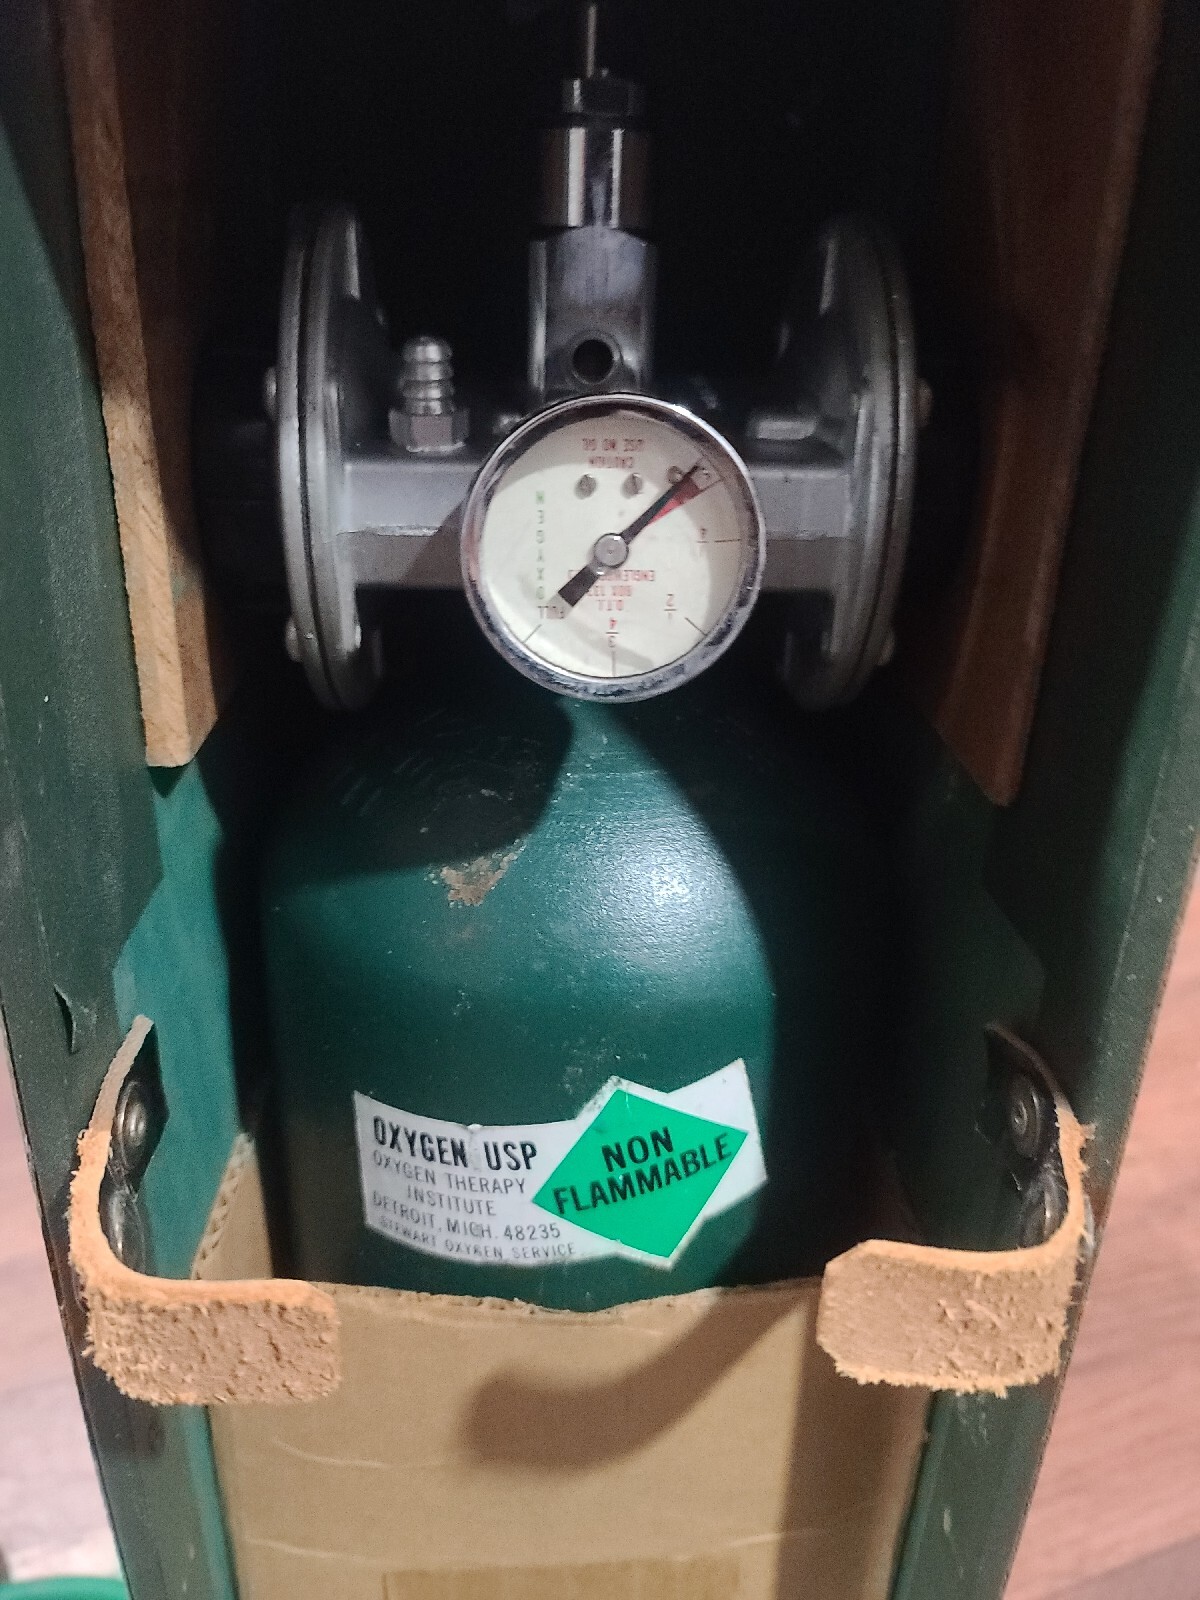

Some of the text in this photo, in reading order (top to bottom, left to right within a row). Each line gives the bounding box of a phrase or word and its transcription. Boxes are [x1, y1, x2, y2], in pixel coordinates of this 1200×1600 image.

[373, 1115, 537, 1171] OXYGEN USP
[601, 1126, 674, 1173] NON
[373, 1149, 525, 1194] OXYGEN THERAPY
[552, 1132, 732, 1215] FLAMMABLE
[407, 1185, 497, 1216] INSTITUTE
[503, 1222, 561, 1241] 48235
[512, 1242, 577, 1259] SERVICE
